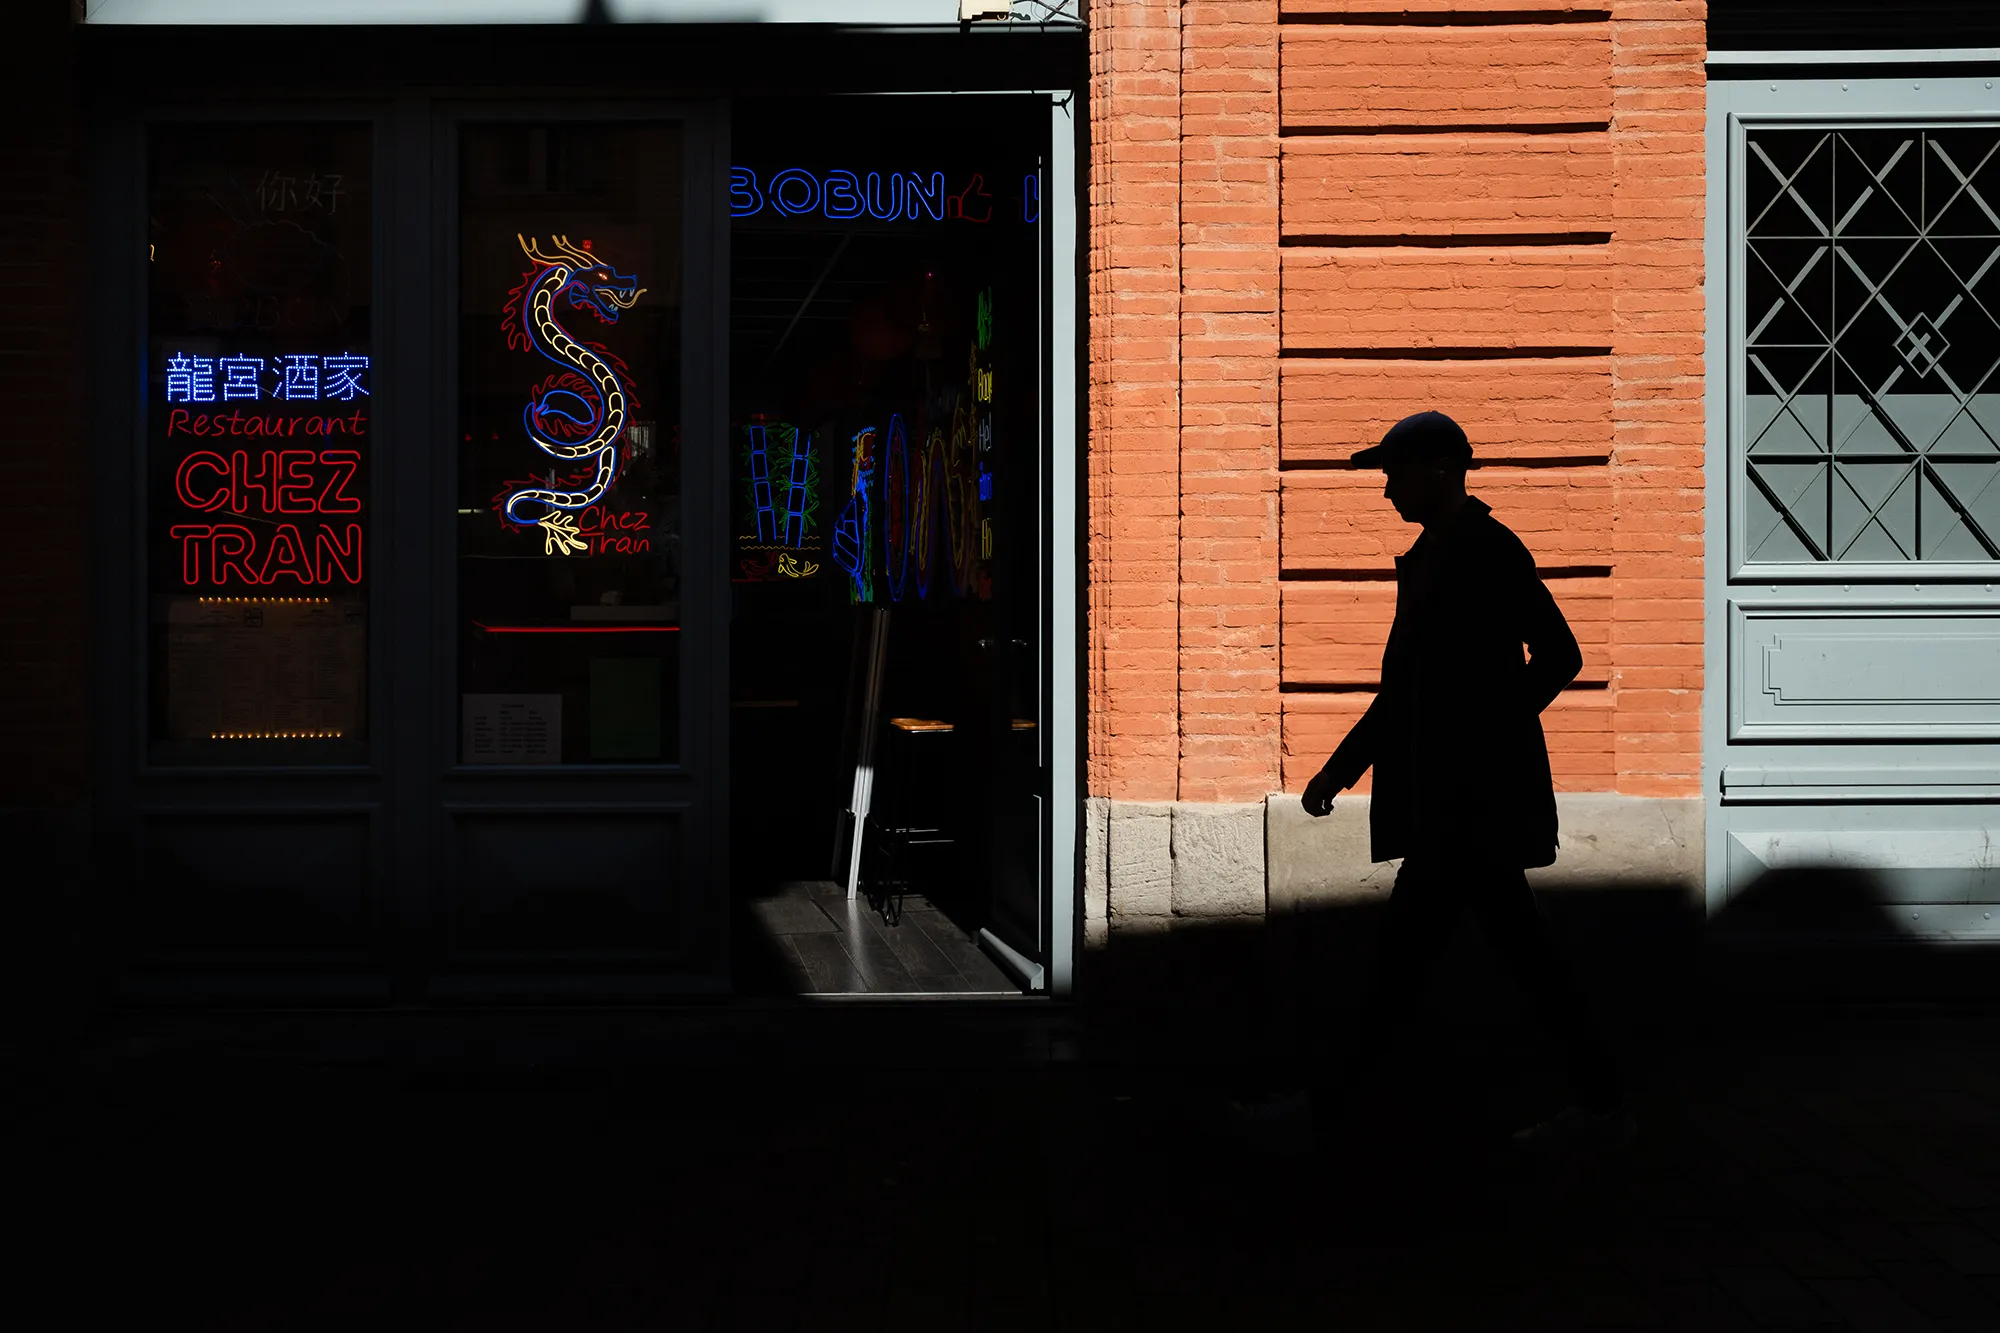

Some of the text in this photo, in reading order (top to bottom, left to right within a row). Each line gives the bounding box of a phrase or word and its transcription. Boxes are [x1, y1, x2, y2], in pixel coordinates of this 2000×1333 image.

[255, 169, 347, 217] 你好
[730, 166, 944, 222] BOBUN
[166, 351, 370, 402] 龍宮酒家
[168, 409, 369, 437] Restaurant
[175, 450, 362, 514] CHEZ
[578, 505, 652, 532] Chez
[169, 523, 363, 585] TRAN
[579, 531, 651, 556] Tran
